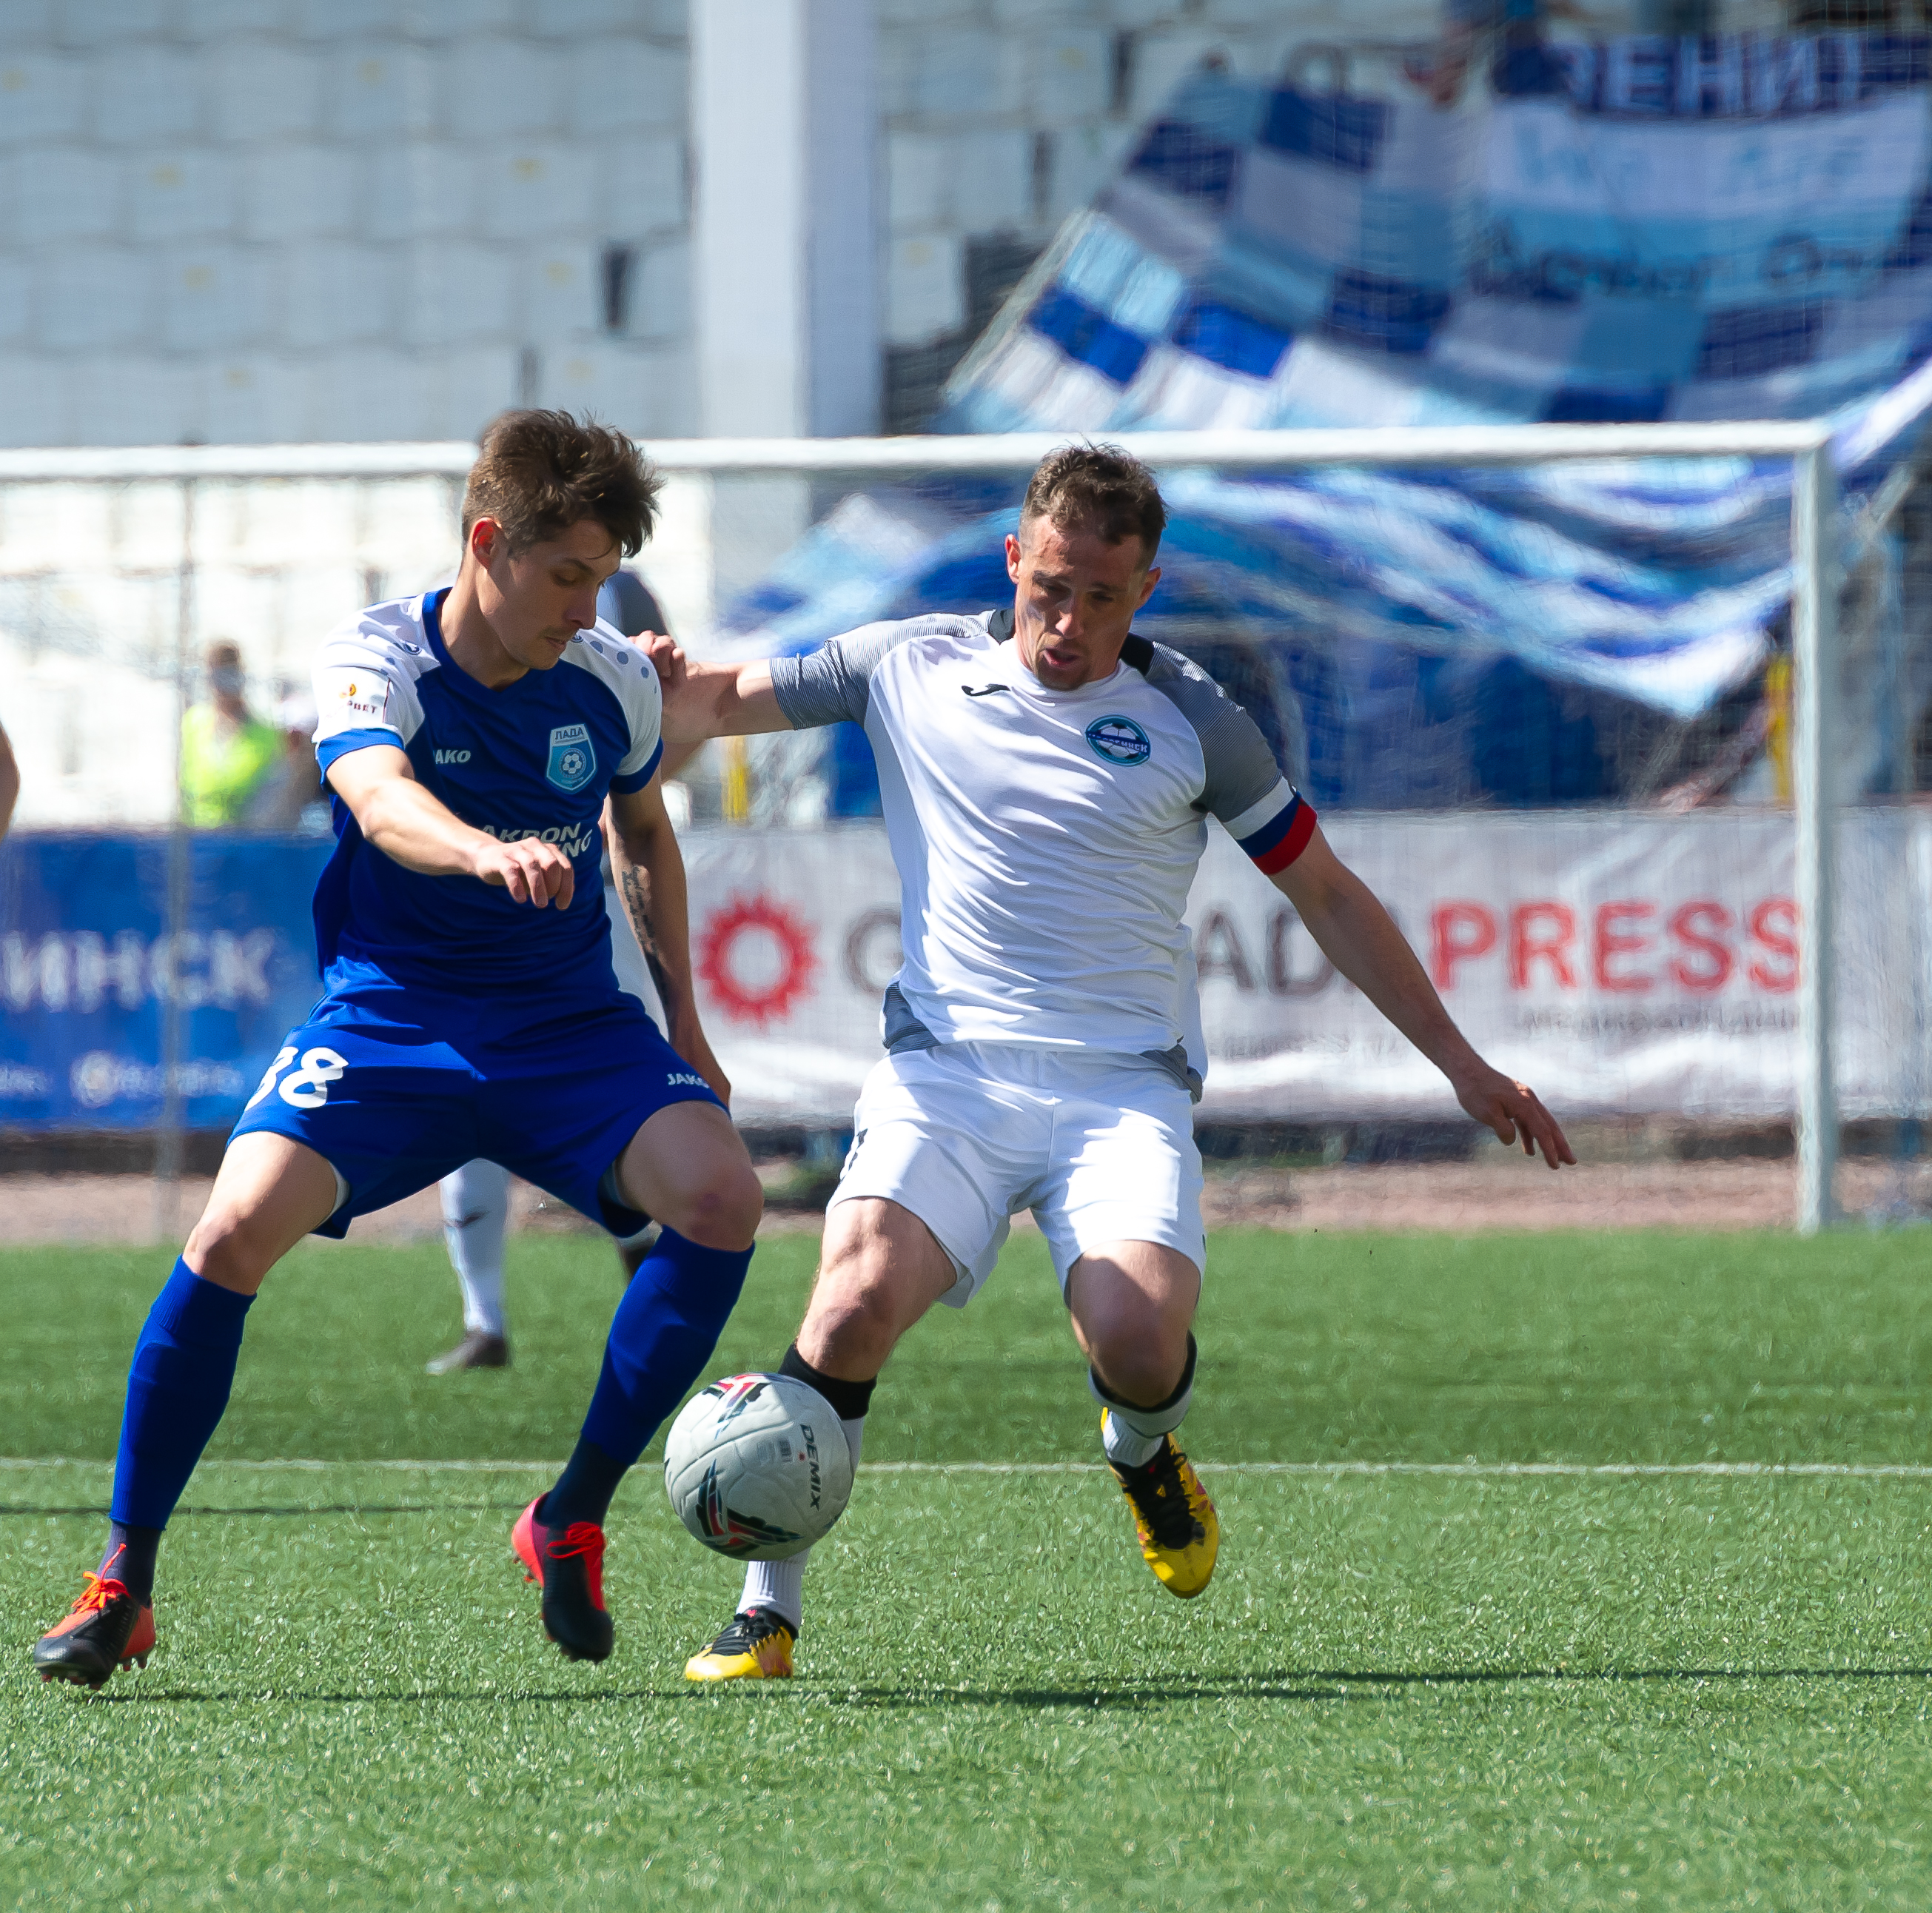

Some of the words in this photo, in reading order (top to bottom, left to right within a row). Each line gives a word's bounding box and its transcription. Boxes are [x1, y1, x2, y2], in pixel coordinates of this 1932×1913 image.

[433, 749, 471, 764] AKO
[555, 726, 584, 740] ЛАДА
[1429, 896, 1800, 994] PRESS
[799, 1424, 821, 1511] DEMIX
